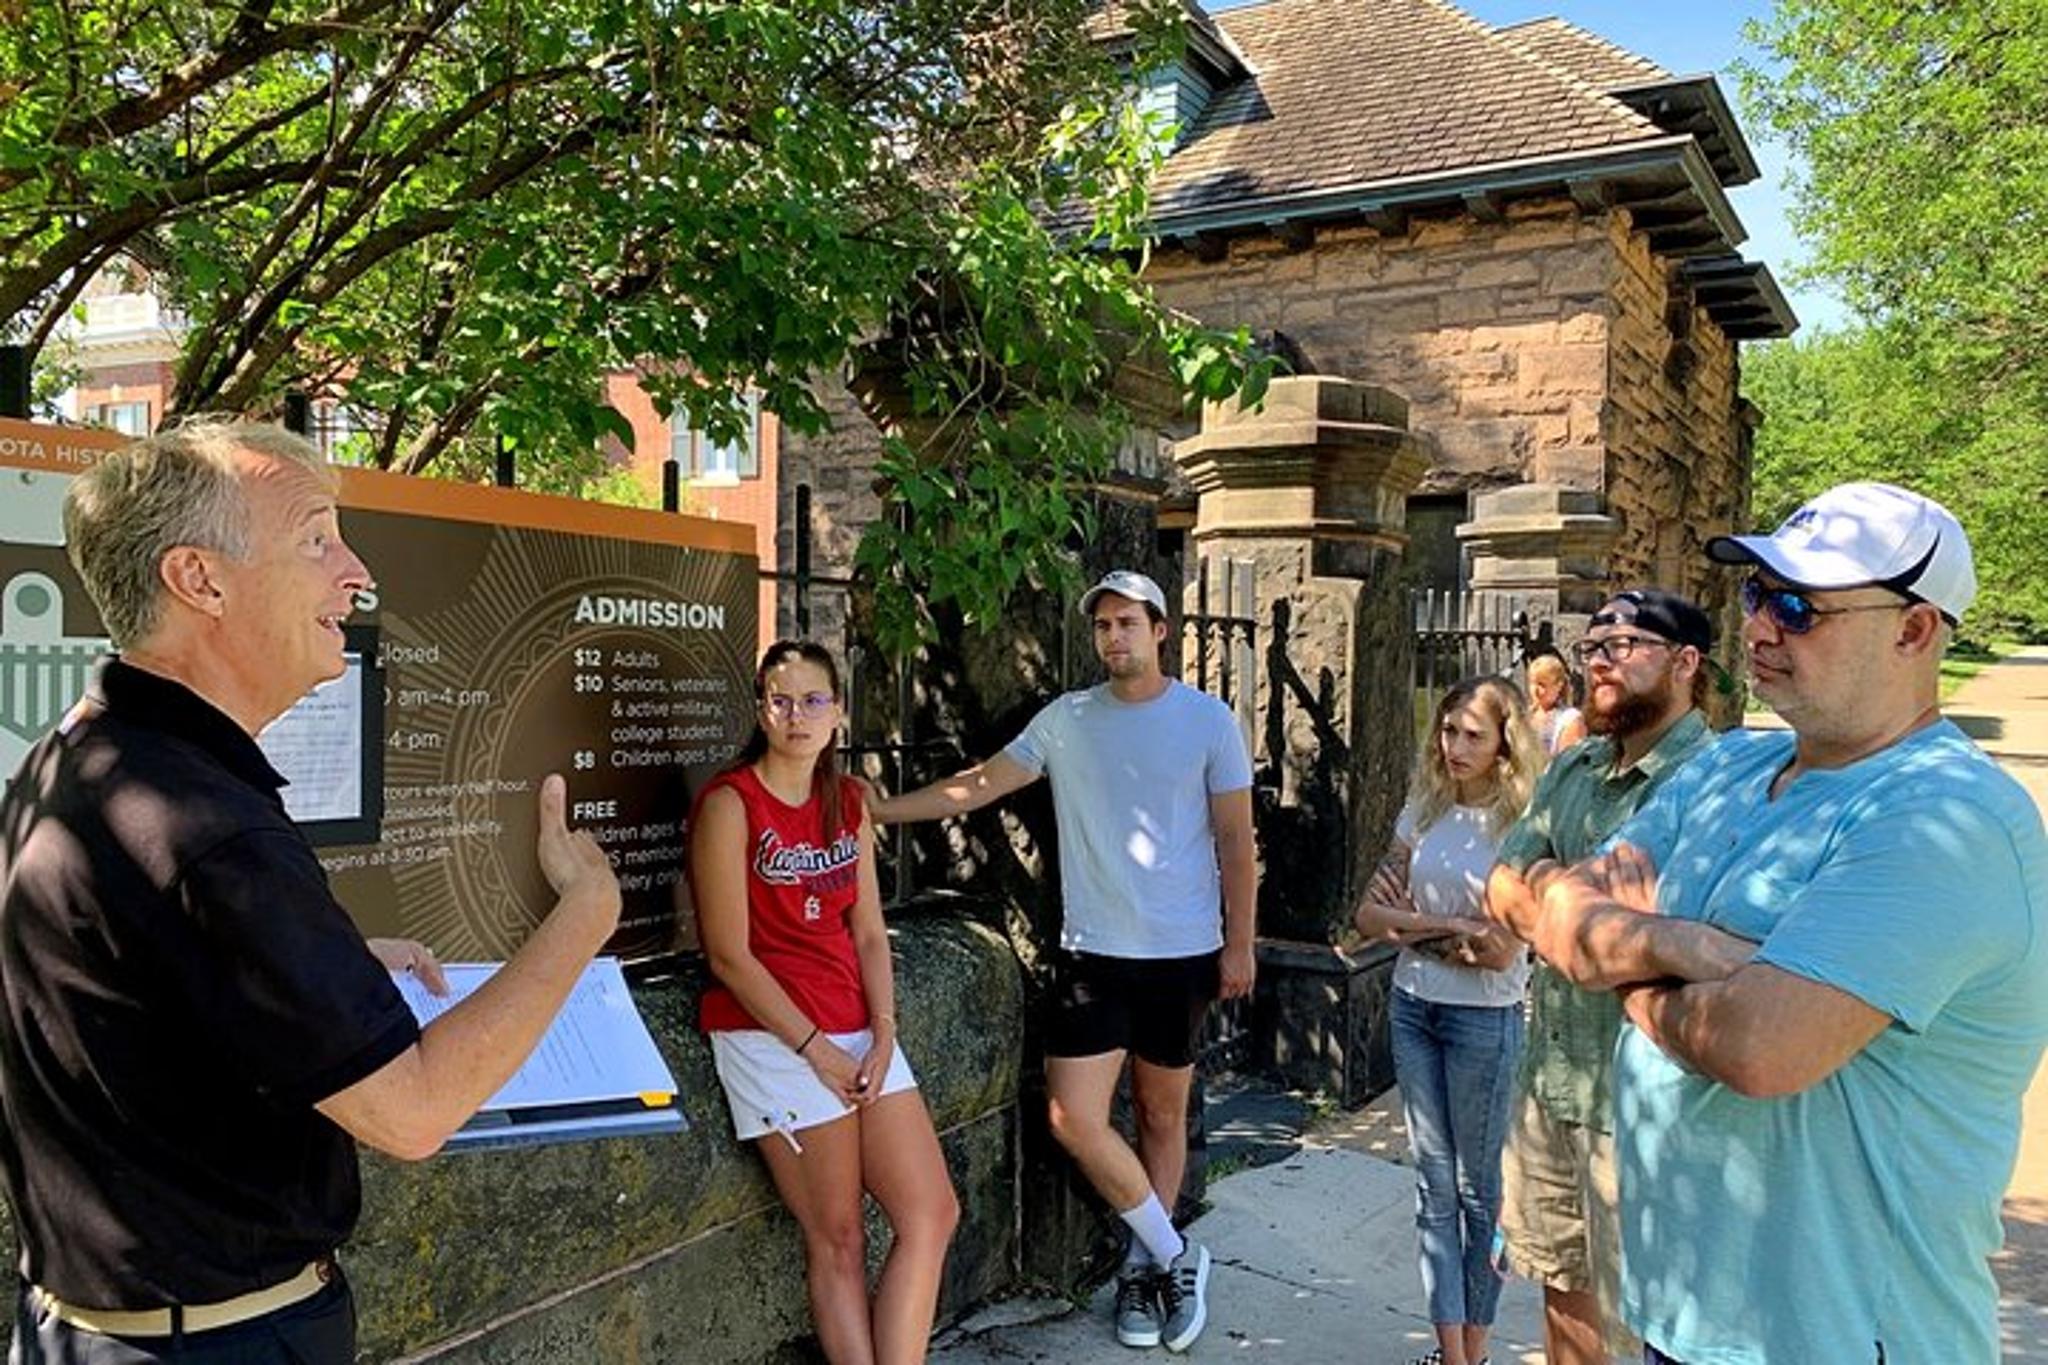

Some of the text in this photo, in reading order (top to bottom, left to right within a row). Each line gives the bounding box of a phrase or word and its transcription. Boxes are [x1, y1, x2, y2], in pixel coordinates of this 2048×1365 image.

[574, 596, 725, 630] ADMISSION
[377, 642, 440, 666] losed
[574, 649, 660, 669] $12 Adults
[574, 674, 603, 692] $10
[611, 701, 623, 718] &
[611, 725, 663, 744] college
[574, 750, 596, 770] $8
[611, 748, 672, 769] Children
[573, 801, 617, 820] FREE
